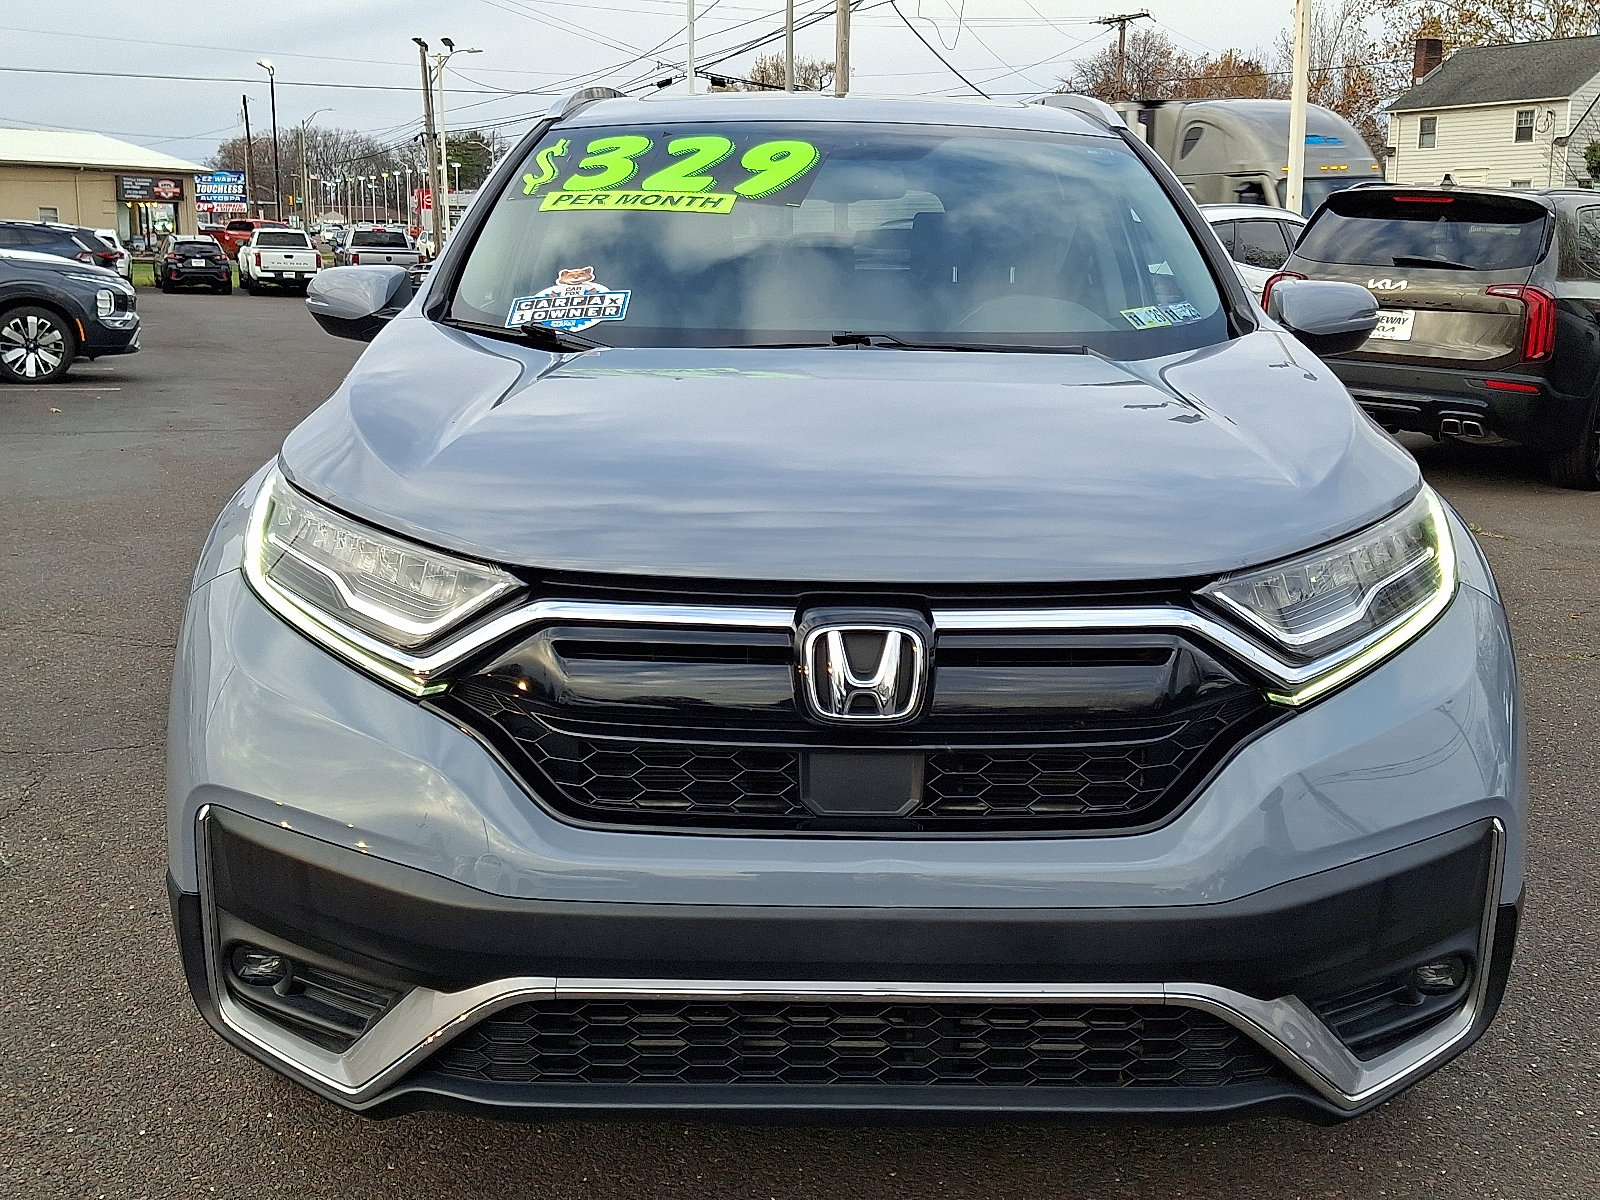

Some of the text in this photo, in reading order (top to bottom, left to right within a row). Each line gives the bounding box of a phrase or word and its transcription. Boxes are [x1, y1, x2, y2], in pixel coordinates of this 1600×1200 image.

[523, 135, 821, 200] $329
[196, 184, 243, 194] TOUCHLESS
[551, 194, 725, 209] PER MONTH
[1367, 279, 1409, 291] KIA
[518, 296, 620, 311] CARFAX
